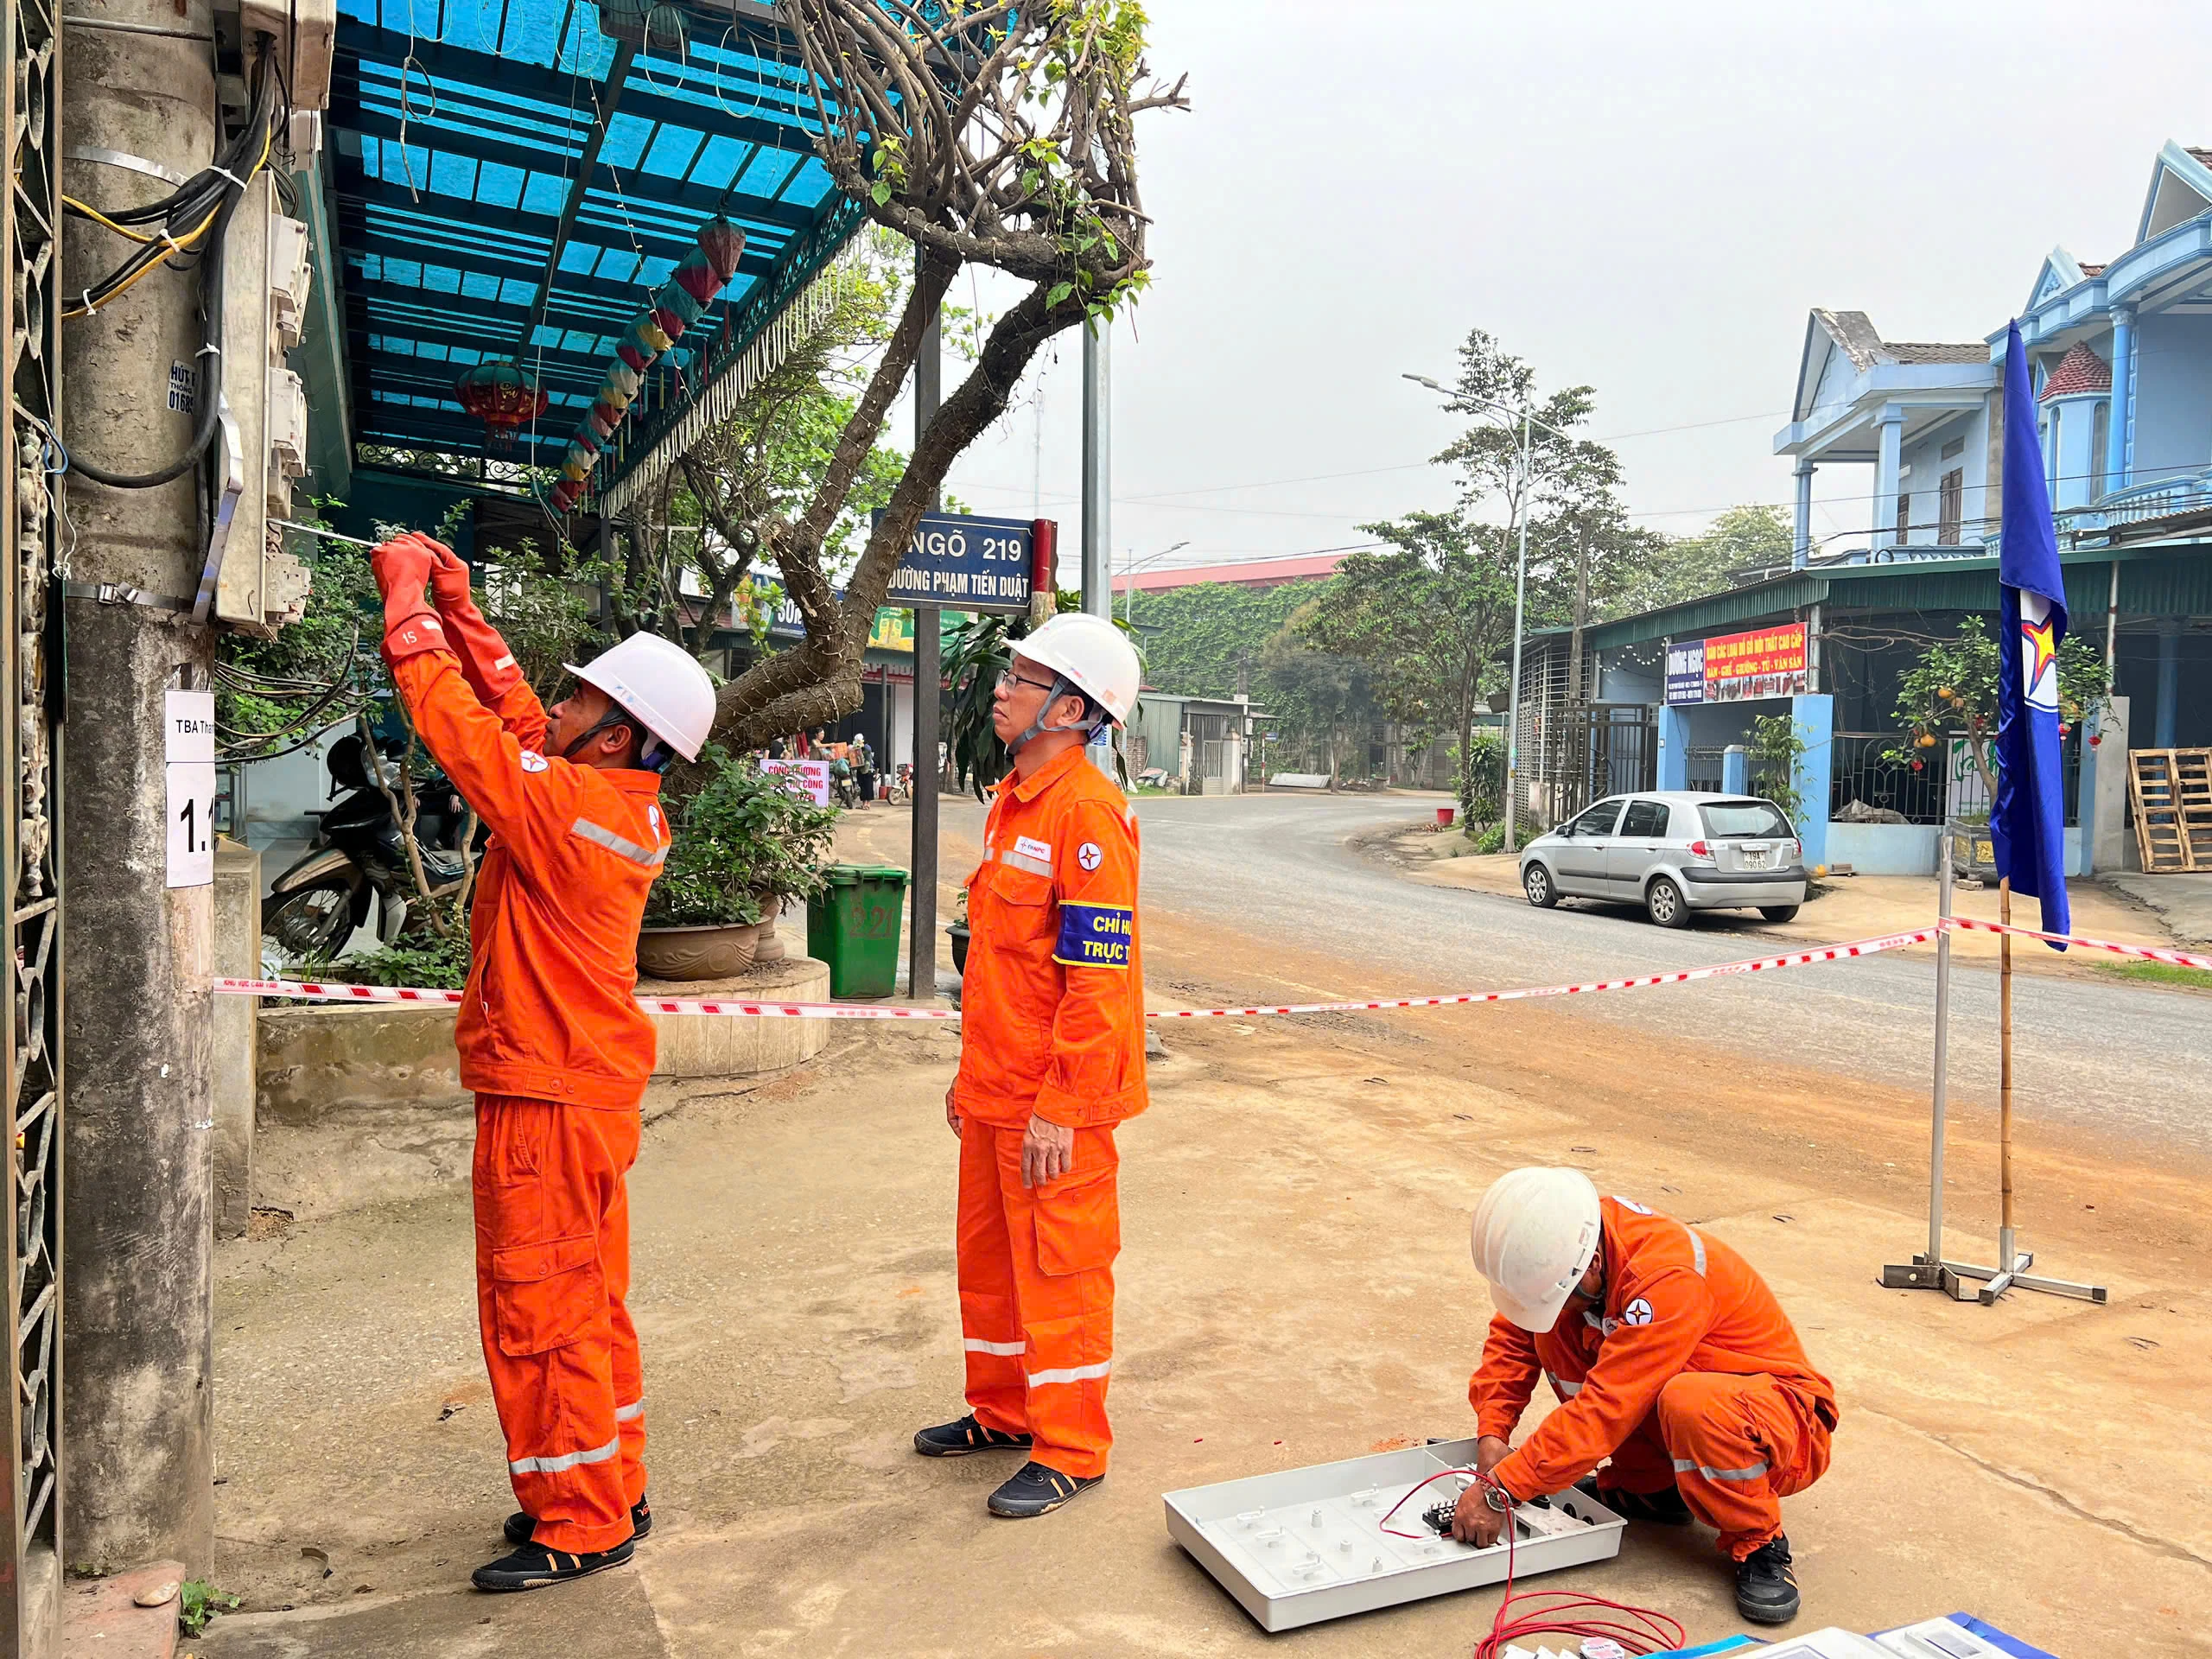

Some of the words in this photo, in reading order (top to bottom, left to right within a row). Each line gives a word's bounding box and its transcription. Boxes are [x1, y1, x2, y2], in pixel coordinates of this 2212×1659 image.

[908, 529, 967, 557] NGÕ
[983, 537, 1022, 562] 219
[933, 571, 968, 597] PHẠM
[971, 569, 997, 596] TIẾN
[1000, 572, 1028, 601] DUẬT
[402, 631, 417, 645] 15
[175, 719, 198, 734] TBA
[803, 778, 823, 789] CÔNG
[1093, 912, 1121, 934] CHỈ
[1083, 941, 1123, 963] TRỰC
